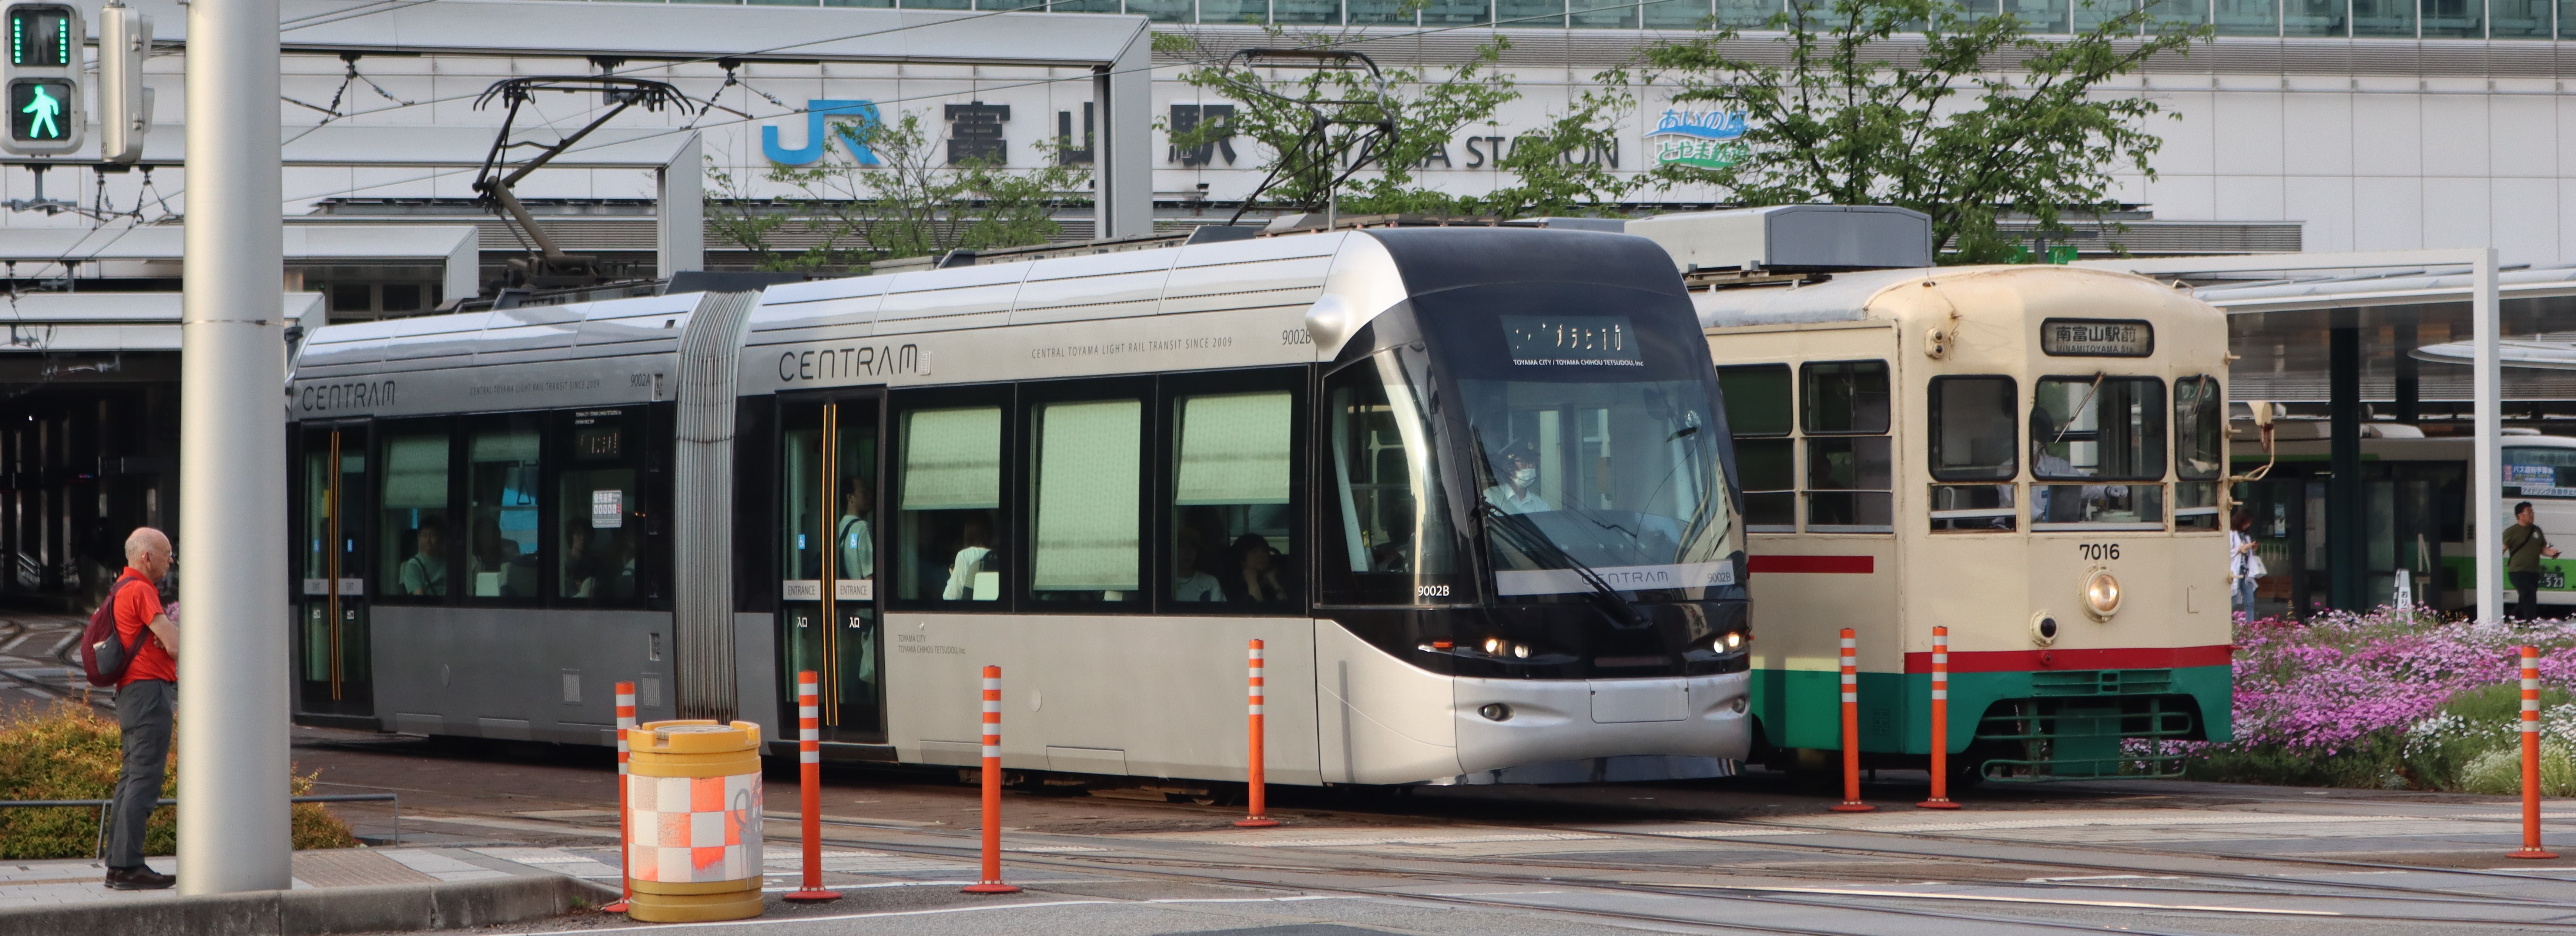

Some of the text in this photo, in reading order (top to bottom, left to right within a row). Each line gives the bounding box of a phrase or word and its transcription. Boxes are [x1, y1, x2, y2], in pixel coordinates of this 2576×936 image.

[762, 100, 880, 165] JR
[1282, 329, 1311, 345] 9002B
[2056, 326, 2136, 342] 南富山駅前
[1032, 336, 1232, 359] CENTRAL TOYAMA LIGHT RAIL TRANSIT SINCE 2009
[779, 343, 918, 382] CENTRAM
[631, 373, 650, 387] 9002A
[302, 380, 395, 412] CENTRAM
[2182, 385, 2212, 399] ワンン
[2080, 543, 2120, 560] 7016
[1708, 573, 1731, 583] 9002B
[788, 586, 815, 596] ENTRANCE
[840, 586, 867, 596] ENTRANCE
[1418, 585, 1450, 597] 9002B
[797, 617, 808, 628] 入口
[849, 617, 860, 628] 入口
[899, 645, 916, 653] TOYAMA
[917, 645, 934, 654] CHIHOU
